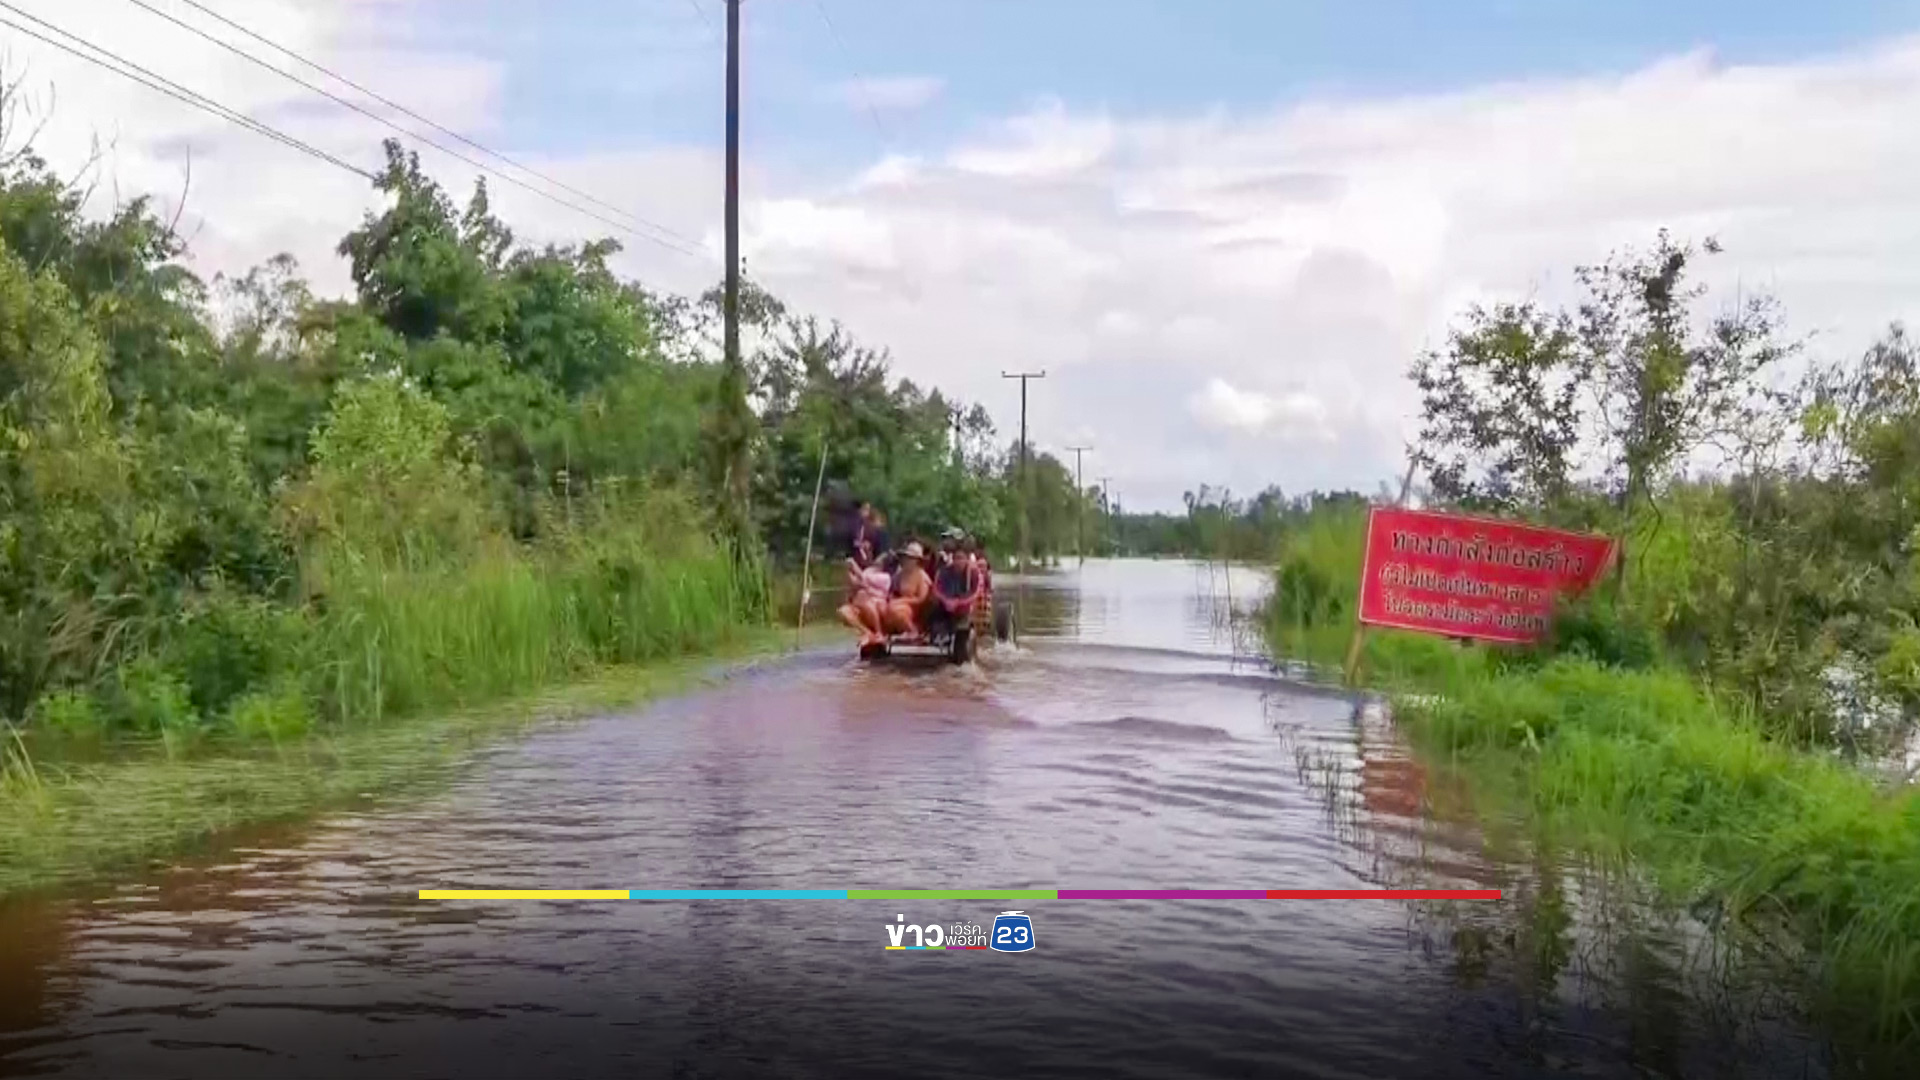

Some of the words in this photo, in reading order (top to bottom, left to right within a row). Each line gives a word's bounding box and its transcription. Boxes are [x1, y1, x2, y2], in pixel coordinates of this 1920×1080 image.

[1391, 528, 1585, 575] ทางกำลังก่อสร้าง
